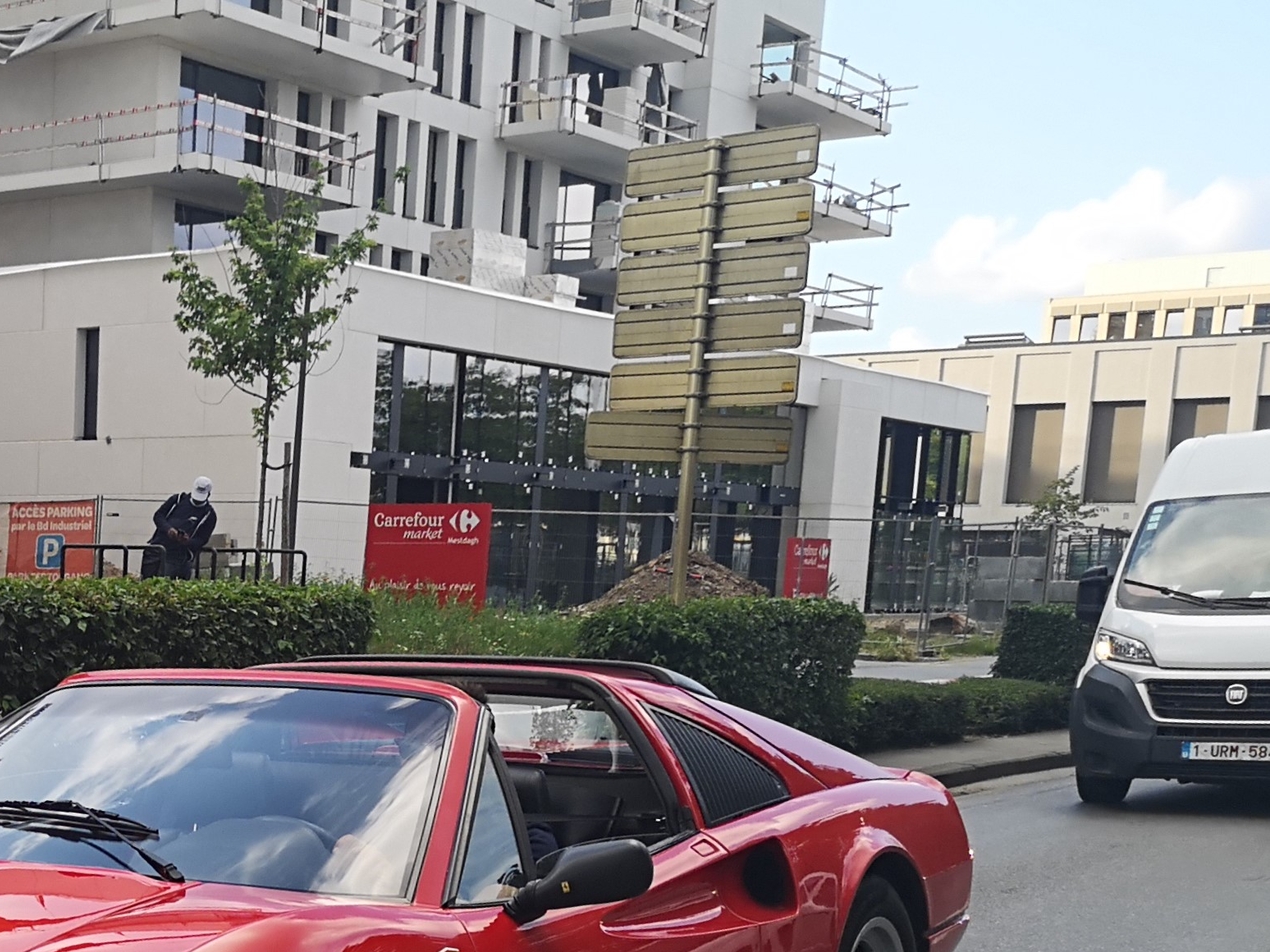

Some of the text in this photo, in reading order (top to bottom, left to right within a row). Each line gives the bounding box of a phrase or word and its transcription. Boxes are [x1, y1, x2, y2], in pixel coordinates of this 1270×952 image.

[12, 504, 93, 518] ACCÈS PARKING
[374, 511, 445, 527] Carrefour
[10, 520, 92, 533] par le Bd Industriel
[403, 528, 444, 540] market
[42, 538, 59, 565] P
[1193, 744, 1270, 758] 1-URM-58
